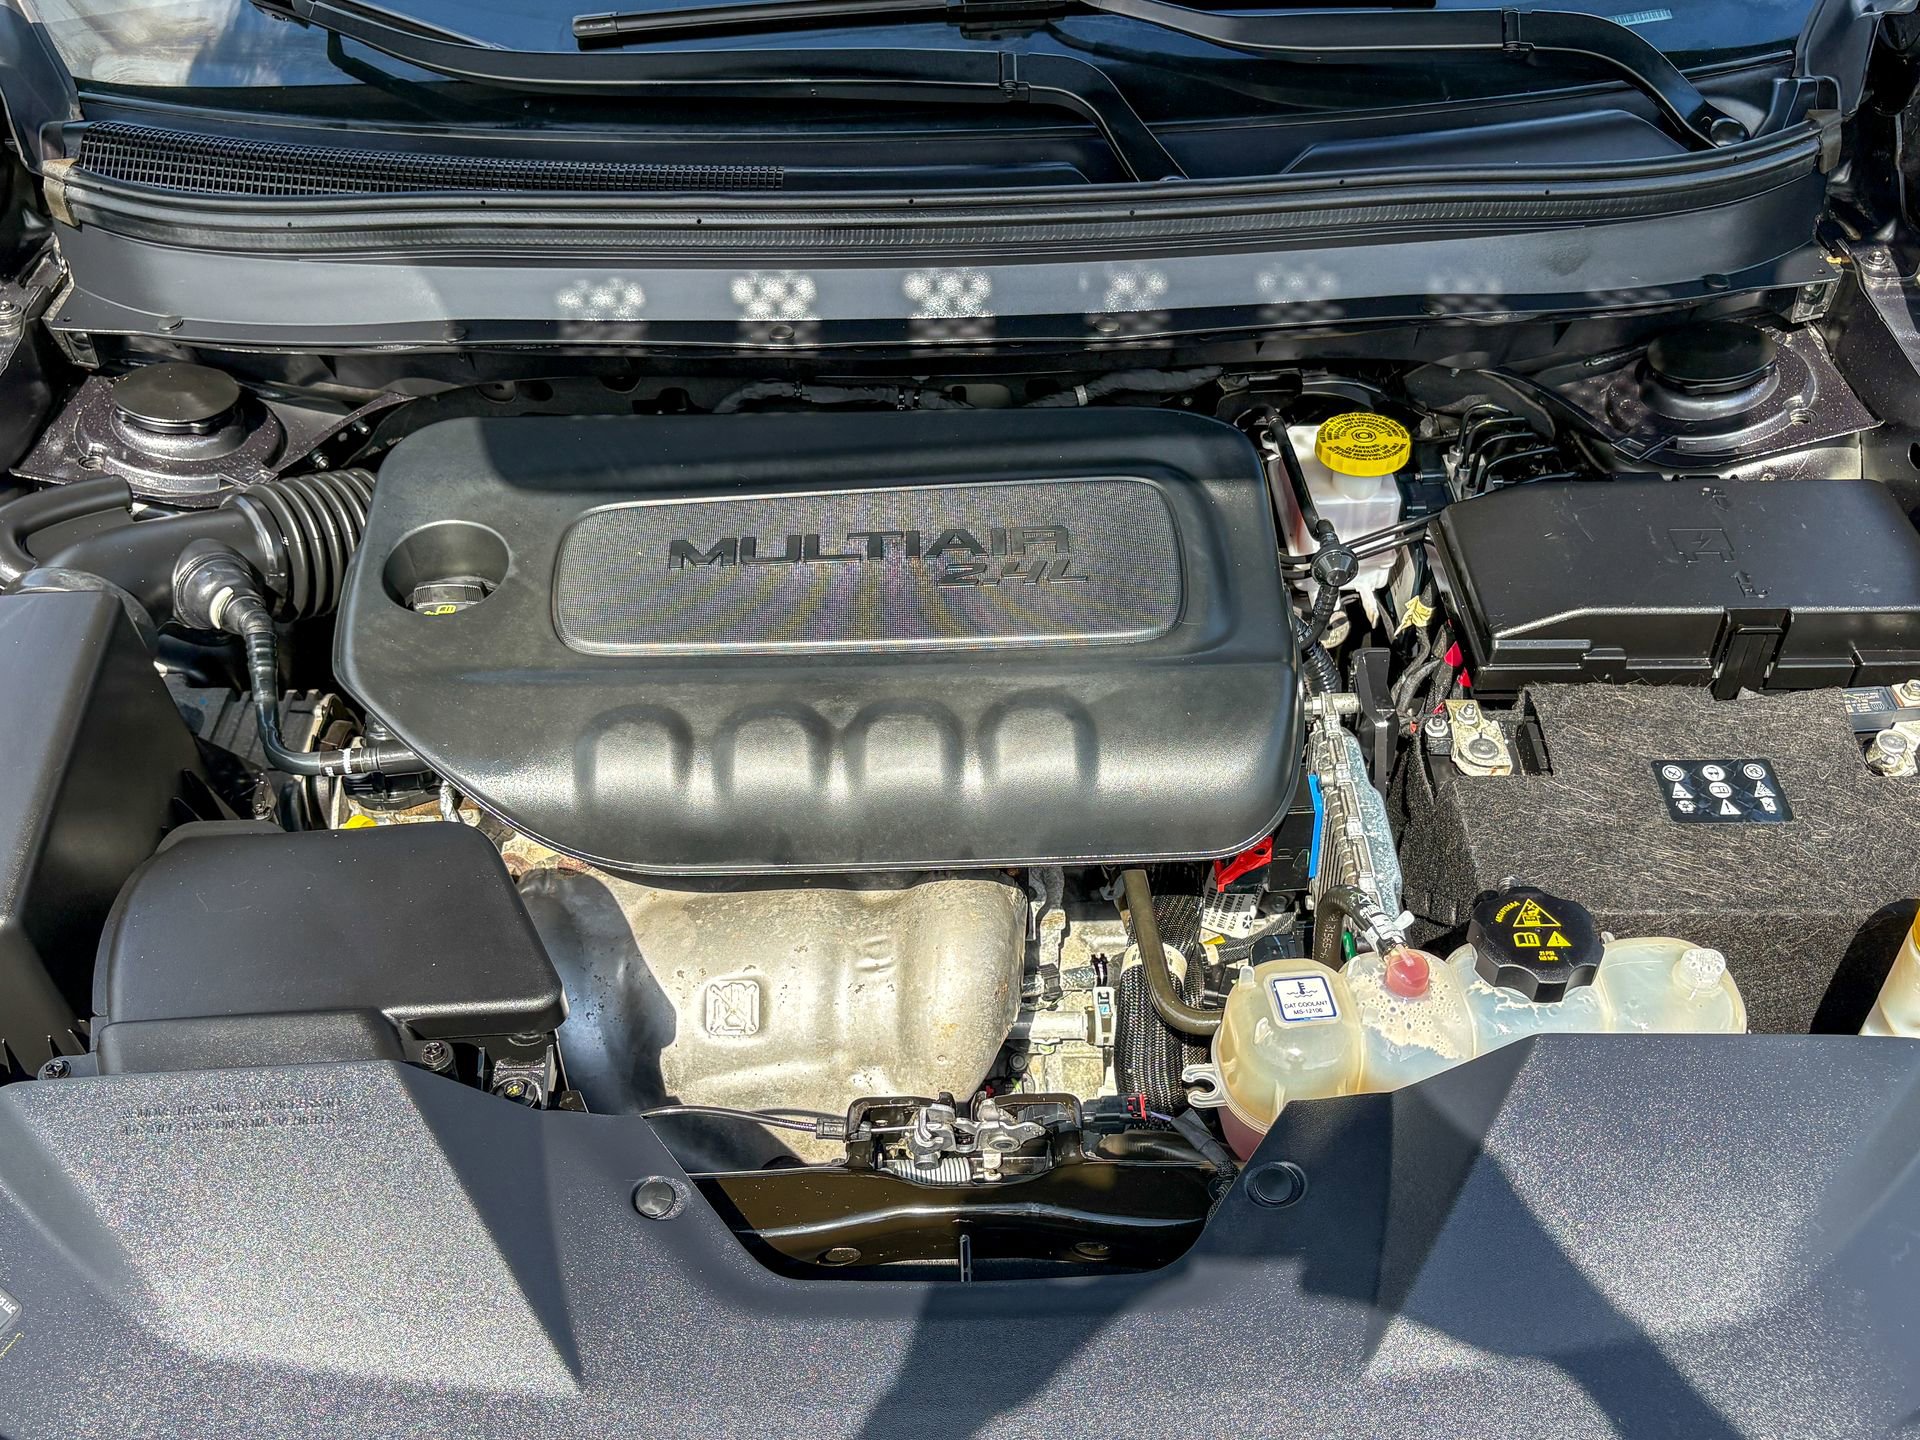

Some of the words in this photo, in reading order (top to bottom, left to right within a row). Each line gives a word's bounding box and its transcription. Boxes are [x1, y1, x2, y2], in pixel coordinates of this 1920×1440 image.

[668, 524, 1069, 569] MULTIAIR
[936, 559, 1088, 588] 2.4L
[1298, 1000, 1328, 1008] COOLANT
